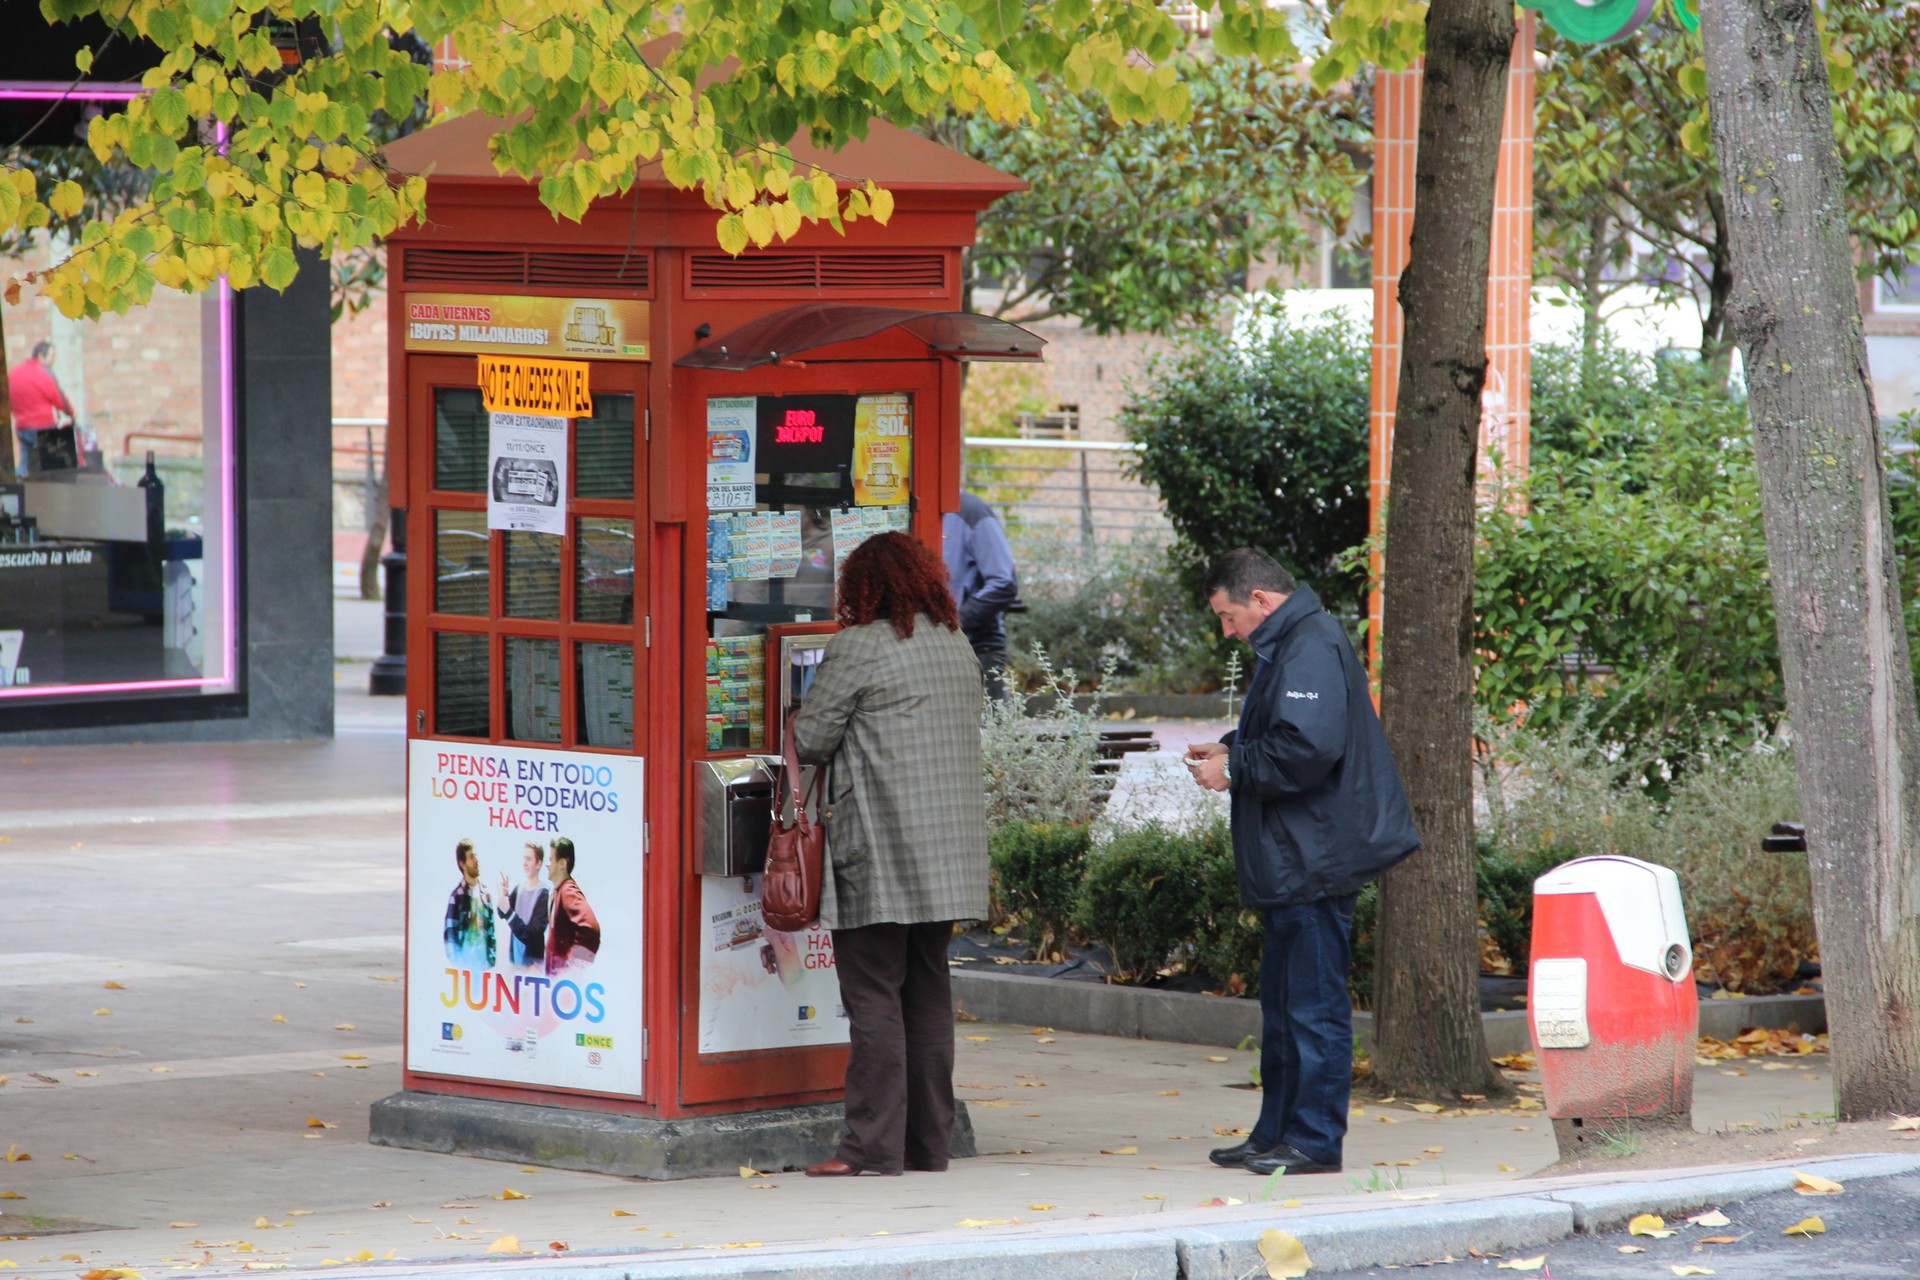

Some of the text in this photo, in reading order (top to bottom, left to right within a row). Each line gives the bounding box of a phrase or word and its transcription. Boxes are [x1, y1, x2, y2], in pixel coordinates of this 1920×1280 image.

[410, 304, 491, 322] CADA VIERNES
[574, 306, 606, 325] EURO
[410, 322, 549, 346] ¡BOTES MILLONARIOS!
[565, 323, 616, 346] JACKPOT
[481, 363, 590, 411] NO TE QUEDES SIN EL
[785, 410, 816, 427] EURO
[876, 415, 909, 437] SOL
[775, 426, 825, 443] JACKPOT
[721, 485, 731, 493] DEL
[732, 484, 752, 492] BARRIO
[66, 548, 93, 565] vida
[438, 753, 613, 787] PIENSA EN TODO
[432, 777, 619, 813] LO QUE PODEMOS
[488, 806, 559, 833] HACER
[440, 967, 605, 1024] JUNTOS
[586, 1036, 612, 1048] ONCE
